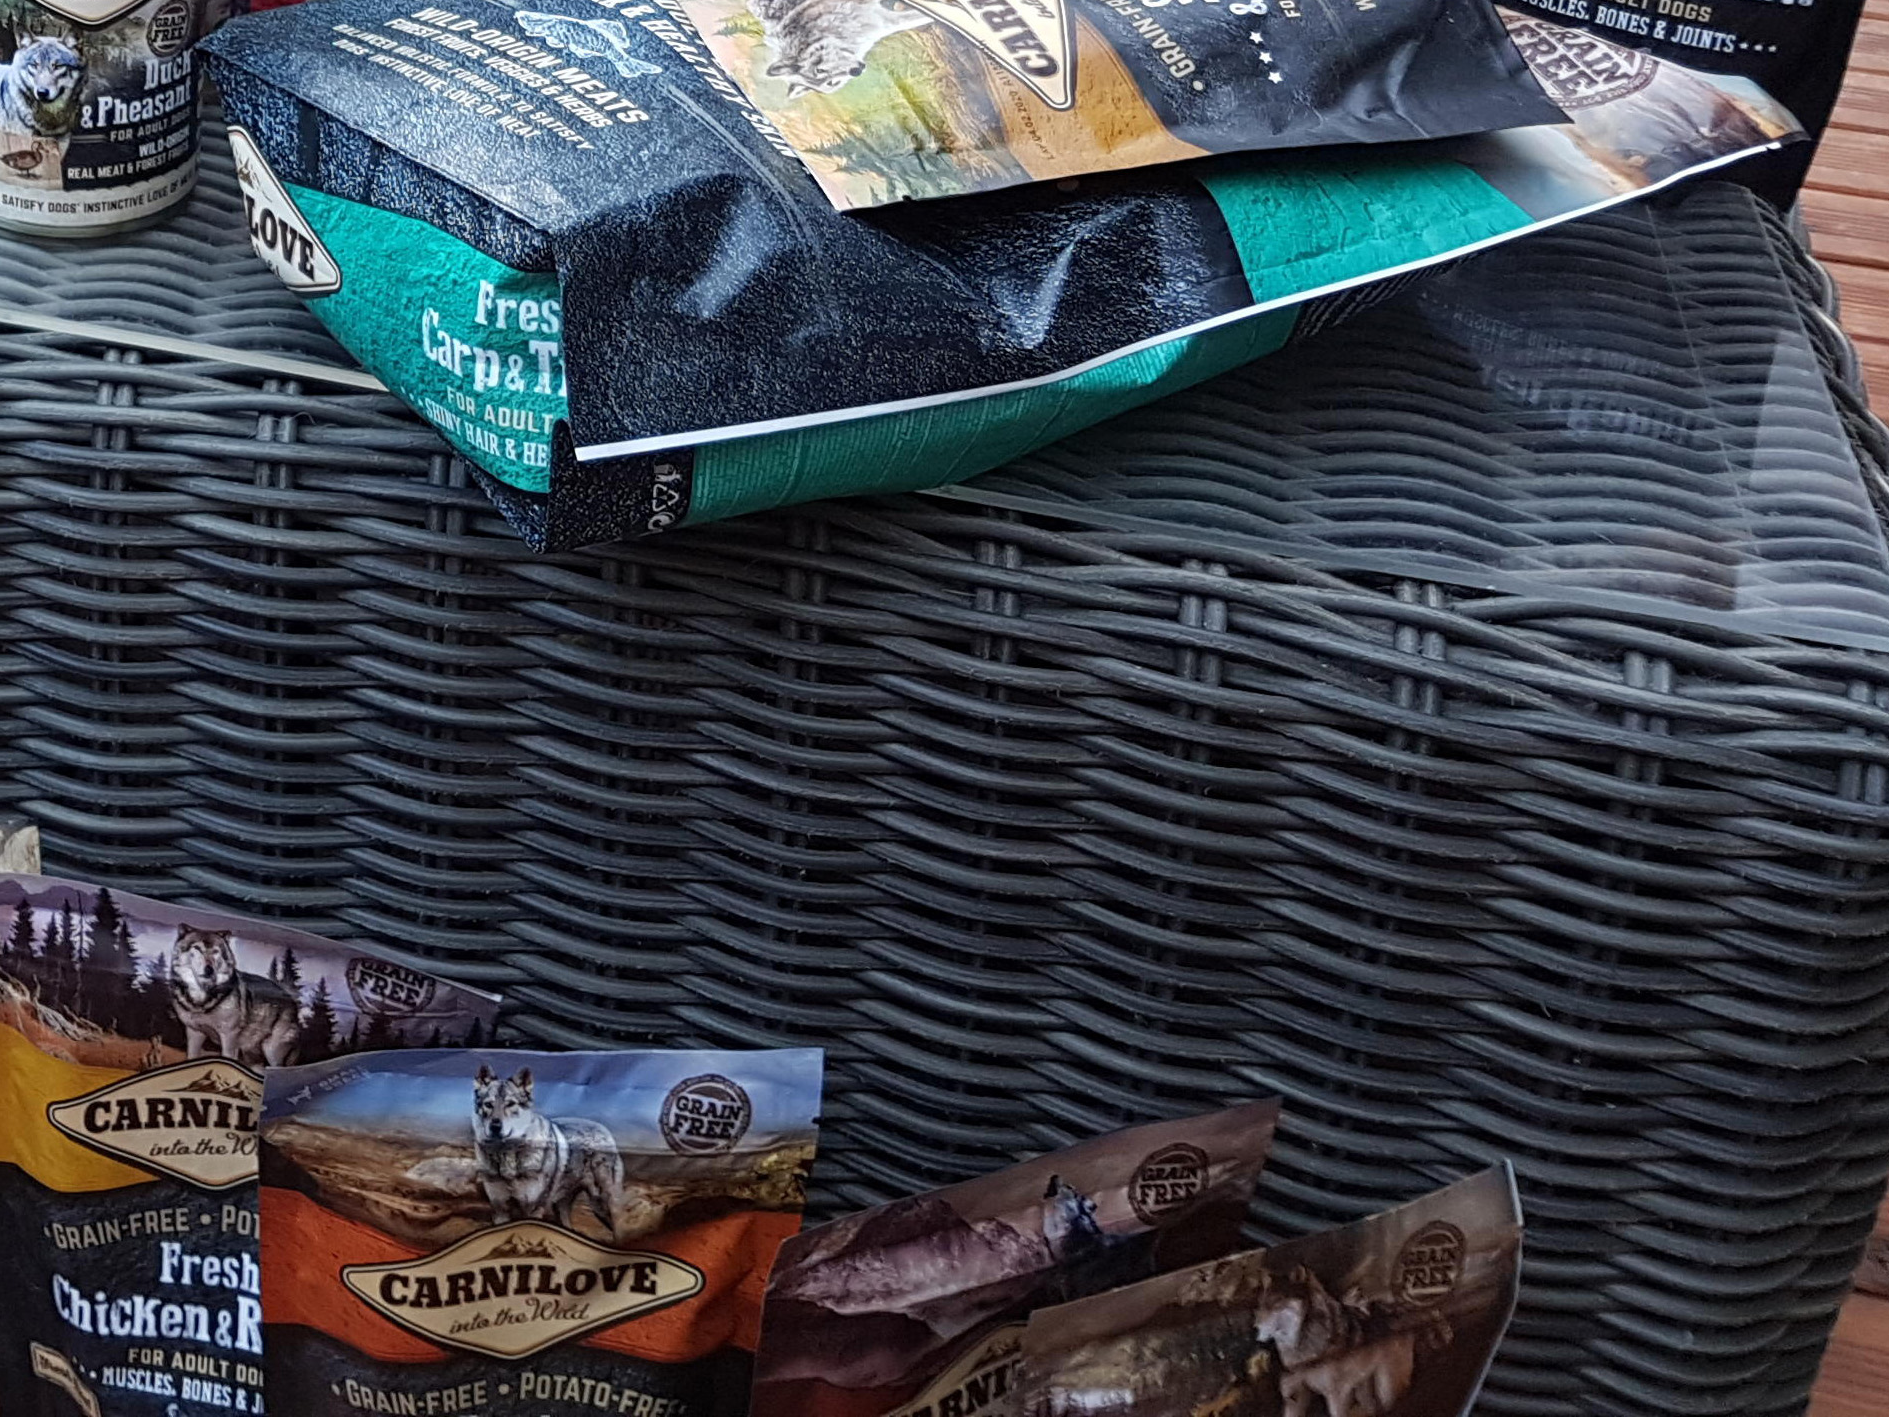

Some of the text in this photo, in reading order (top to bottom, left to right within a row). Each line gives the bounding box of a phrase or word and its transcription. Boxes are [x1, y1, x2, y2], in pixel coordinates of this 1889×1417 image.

[411, 7, 650, 125] WILD-ORIGIN MEATS
[80, 82, 191, 129] & Pheasant
[68, 162, 133, 180] REAL MEAT &
[422, 307, 524, 394] Carp &
[447, 385, 553, 435] FOR ADULT
[356, 971, 422, 1005] FREE
[667, 1113, 736, 1140] FREE
[676, 1097, 743, 1123] GRAIN
[53, 1207, 190, 1250] GRAIN-FREE
[379, 1261, 657, 1309] CARNILOVE
[52, 1273, 233, 1352] Chicken &
[128, 1348, 229, 1378] FOR ADULT
[181, 1376, 230, 1410] BONES
[346, 1380, 488, 1417] GRAIN-FREE
